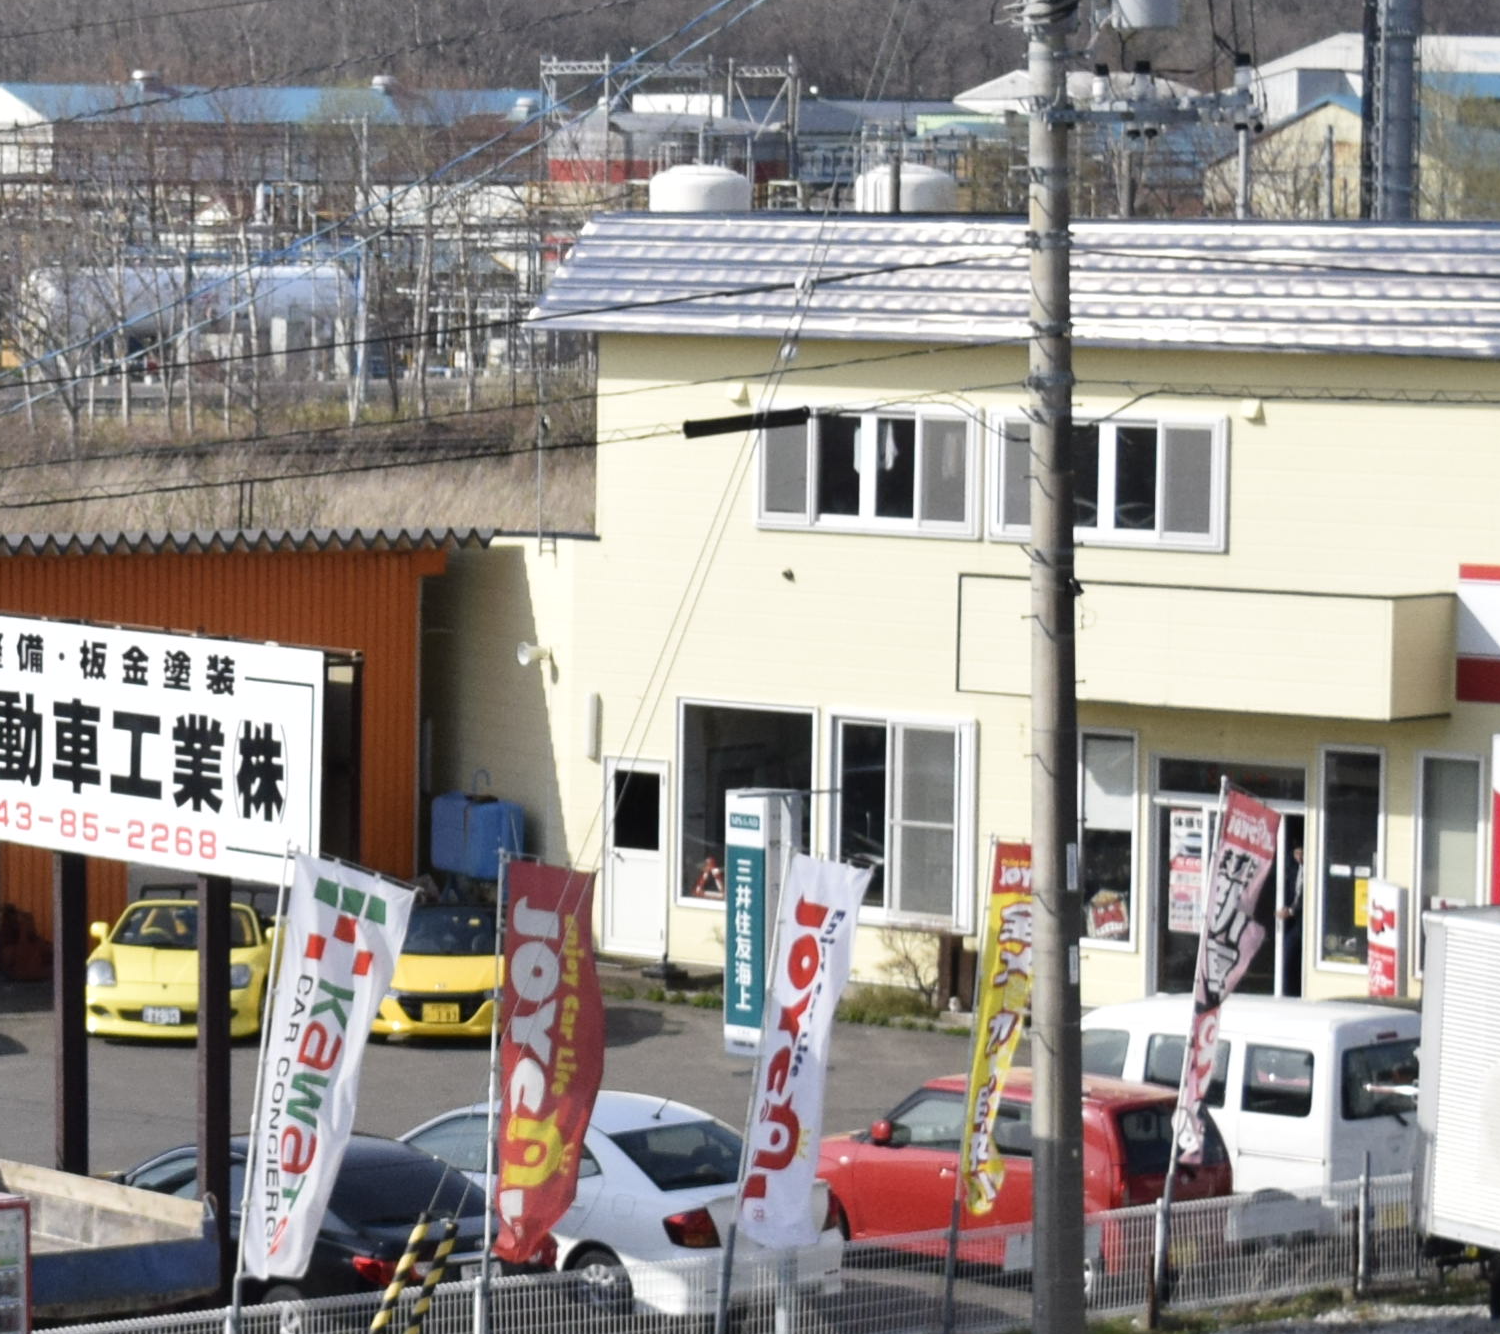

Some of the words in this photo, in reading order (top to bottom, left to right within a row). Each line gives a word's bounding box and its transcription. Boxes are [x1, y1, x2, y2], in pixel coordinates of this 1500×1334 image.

[734, 858, 752, 1012] 三井住友海上
[999, 869, 1032, 891] JOY
[284, 975, 313, 1044] CAR
[500, 896, 565, 1227] JOYCAL
[265, 1056, 291, 1250] CONCIERG
